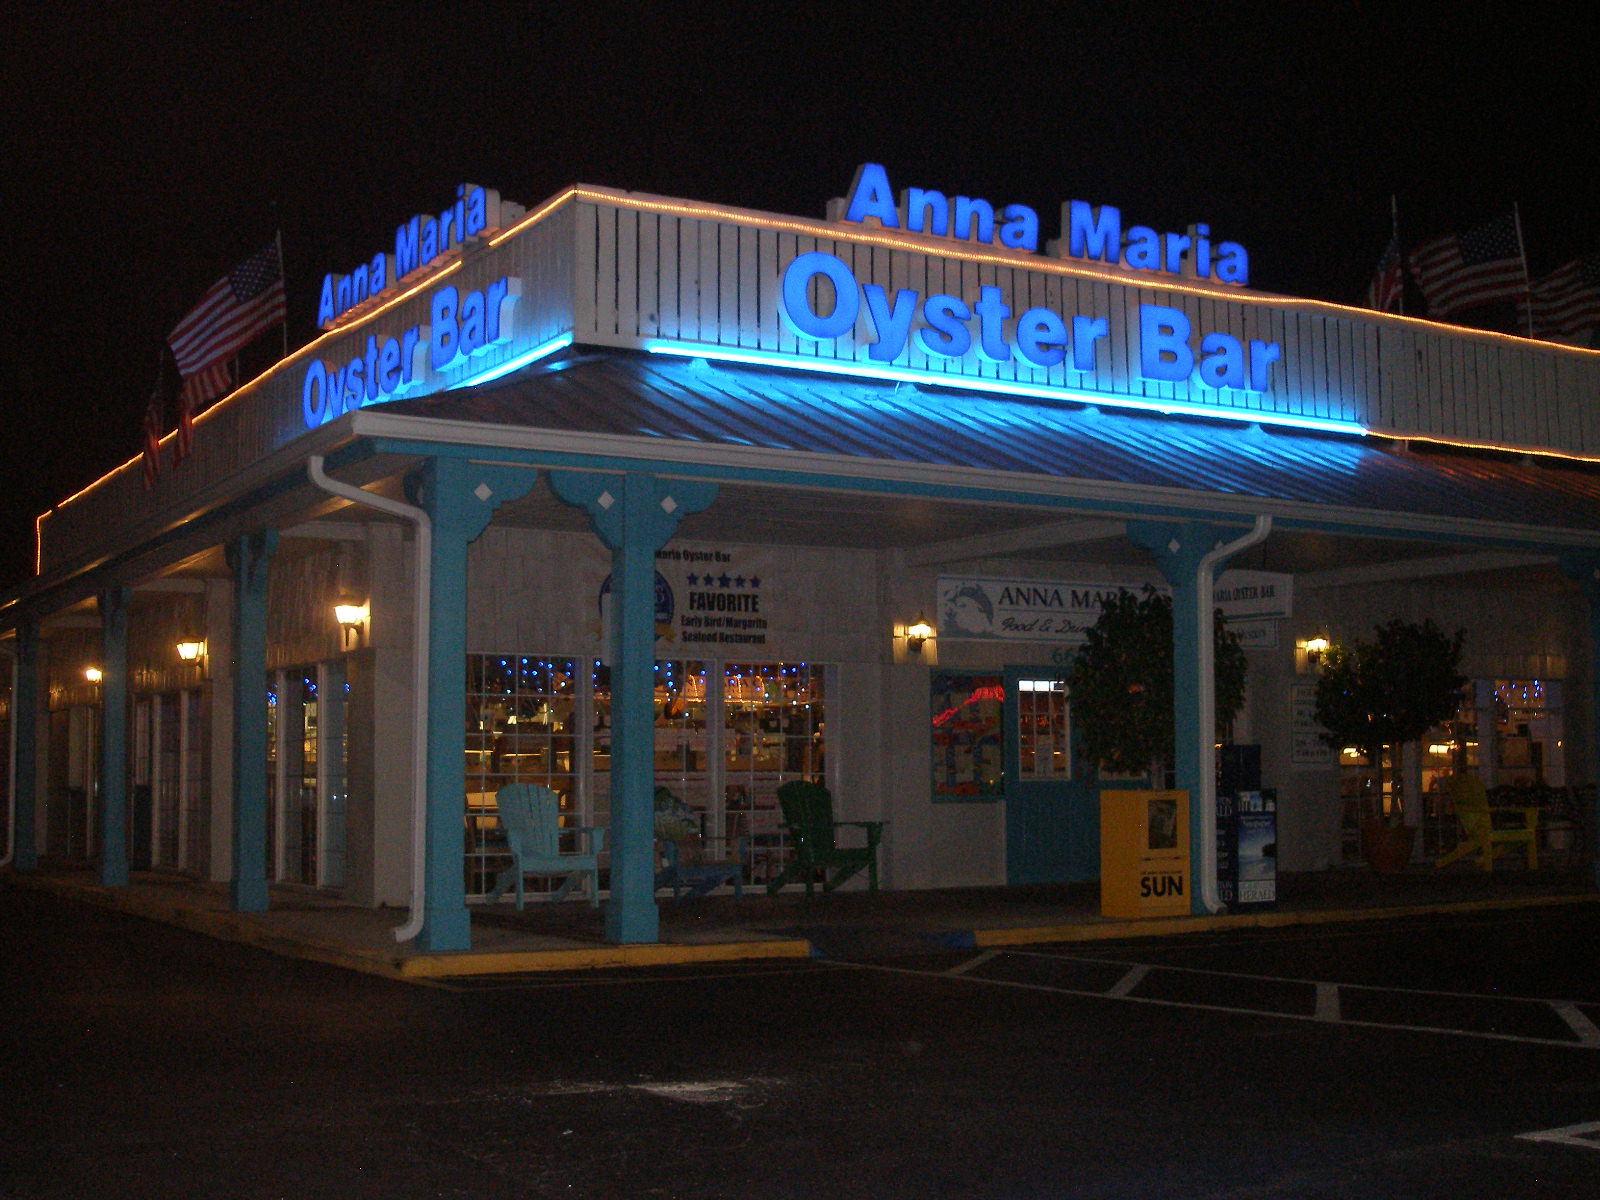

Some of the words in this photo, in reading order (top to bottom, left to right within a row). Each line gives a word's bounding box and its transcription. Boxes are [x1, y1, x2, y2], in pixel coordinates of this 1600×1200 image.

[845, 162, 1039, 253] Anna
[1069, 199, 1250, 286] Maria
[317, 252, 387, 328] Anna
[395, 183, 487, 281] Maria
[782, 251, 1108, 372] Oyster
[1139, 304, 1280, 393] Bar
[303, 325, 420, 429] Oyster
[431, 277, 508, 371] Bar
[683, 550, 713, 563] Oyster
[715, 551, 731, 563] Bar
[689, 592, 759, 612] FAVORITE
[999, 586, 1063, 608] ANNA
[1071, 589, 1120, 609] MAR
[1213, 588, 1231, 602] ARIA
[681, 615, 702, 628] Early
[1001, 616, 1040, 632] Food
[1055, 618, 1089, 633] Drin
[682, 630, 717, 643] Seafood
[719, 631, 765, 644] Restaurant
[1141, 876, 1183, 897] SUN
